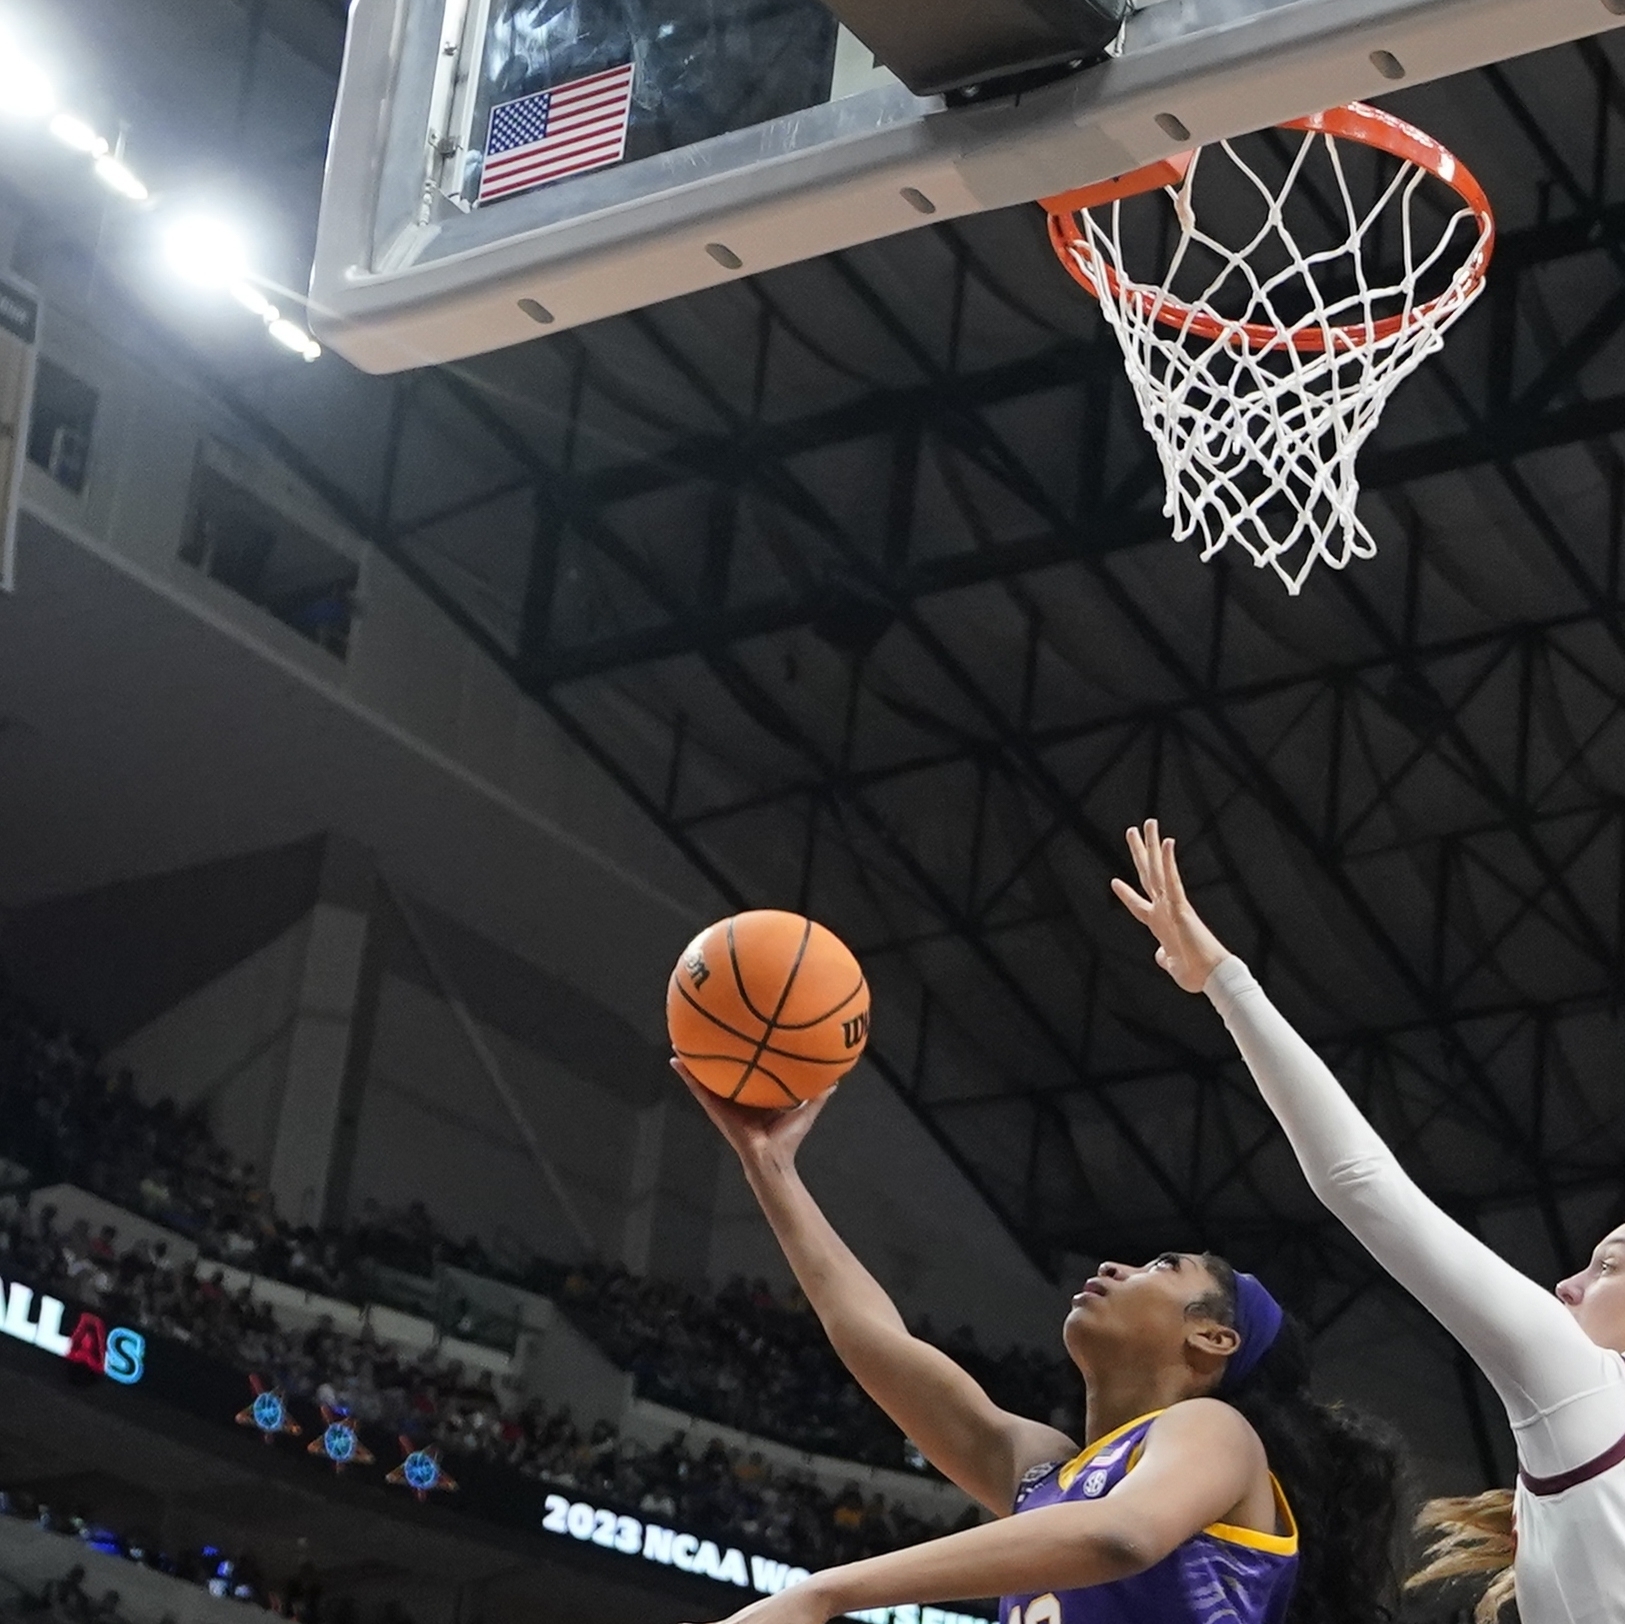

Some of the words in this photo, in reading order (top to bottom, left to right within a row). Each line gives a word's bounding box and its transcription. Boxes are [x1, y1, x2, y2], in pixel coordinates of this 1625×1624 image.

[0, 1275, 146, 1385] LLAS
[542, 1493, 643, 1556] 2023
[642, 1523, 749, 1587] NCAA
